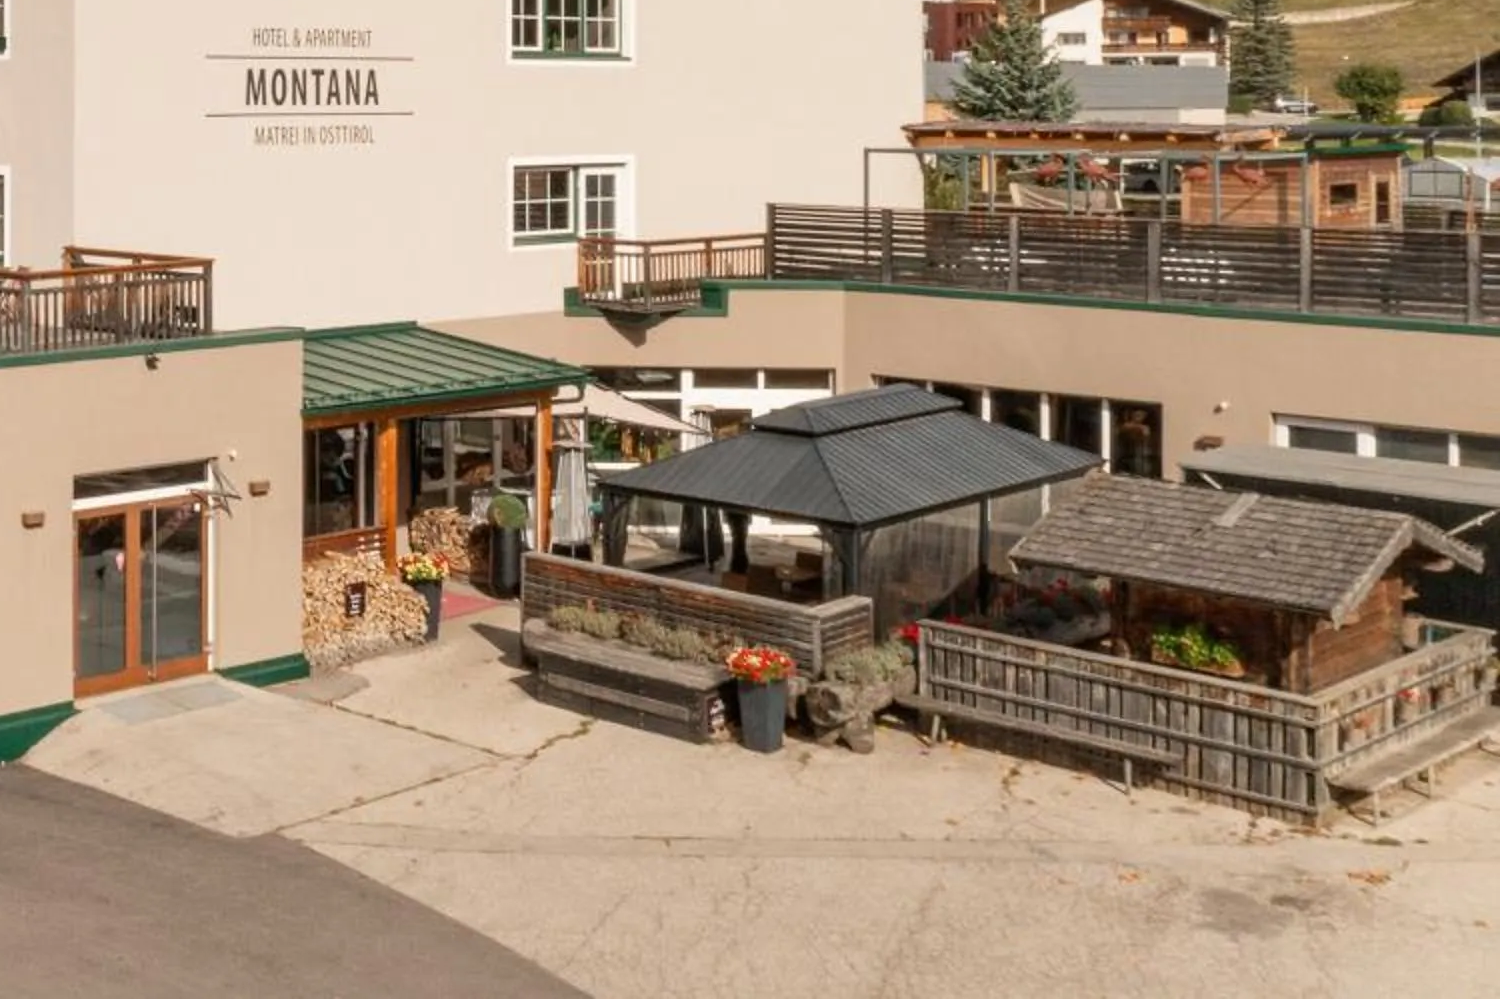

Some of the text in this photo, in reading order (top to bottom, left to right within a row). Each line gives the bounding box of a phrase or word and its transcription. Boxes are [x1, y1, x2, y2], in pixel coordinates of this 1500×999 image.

[253, 27, 373, 49] HOTEL & APARTMENT
[245, 67, 380, 106] MONTANA
[254, 125, 376, 146] MATREI IN OSTTIROL
